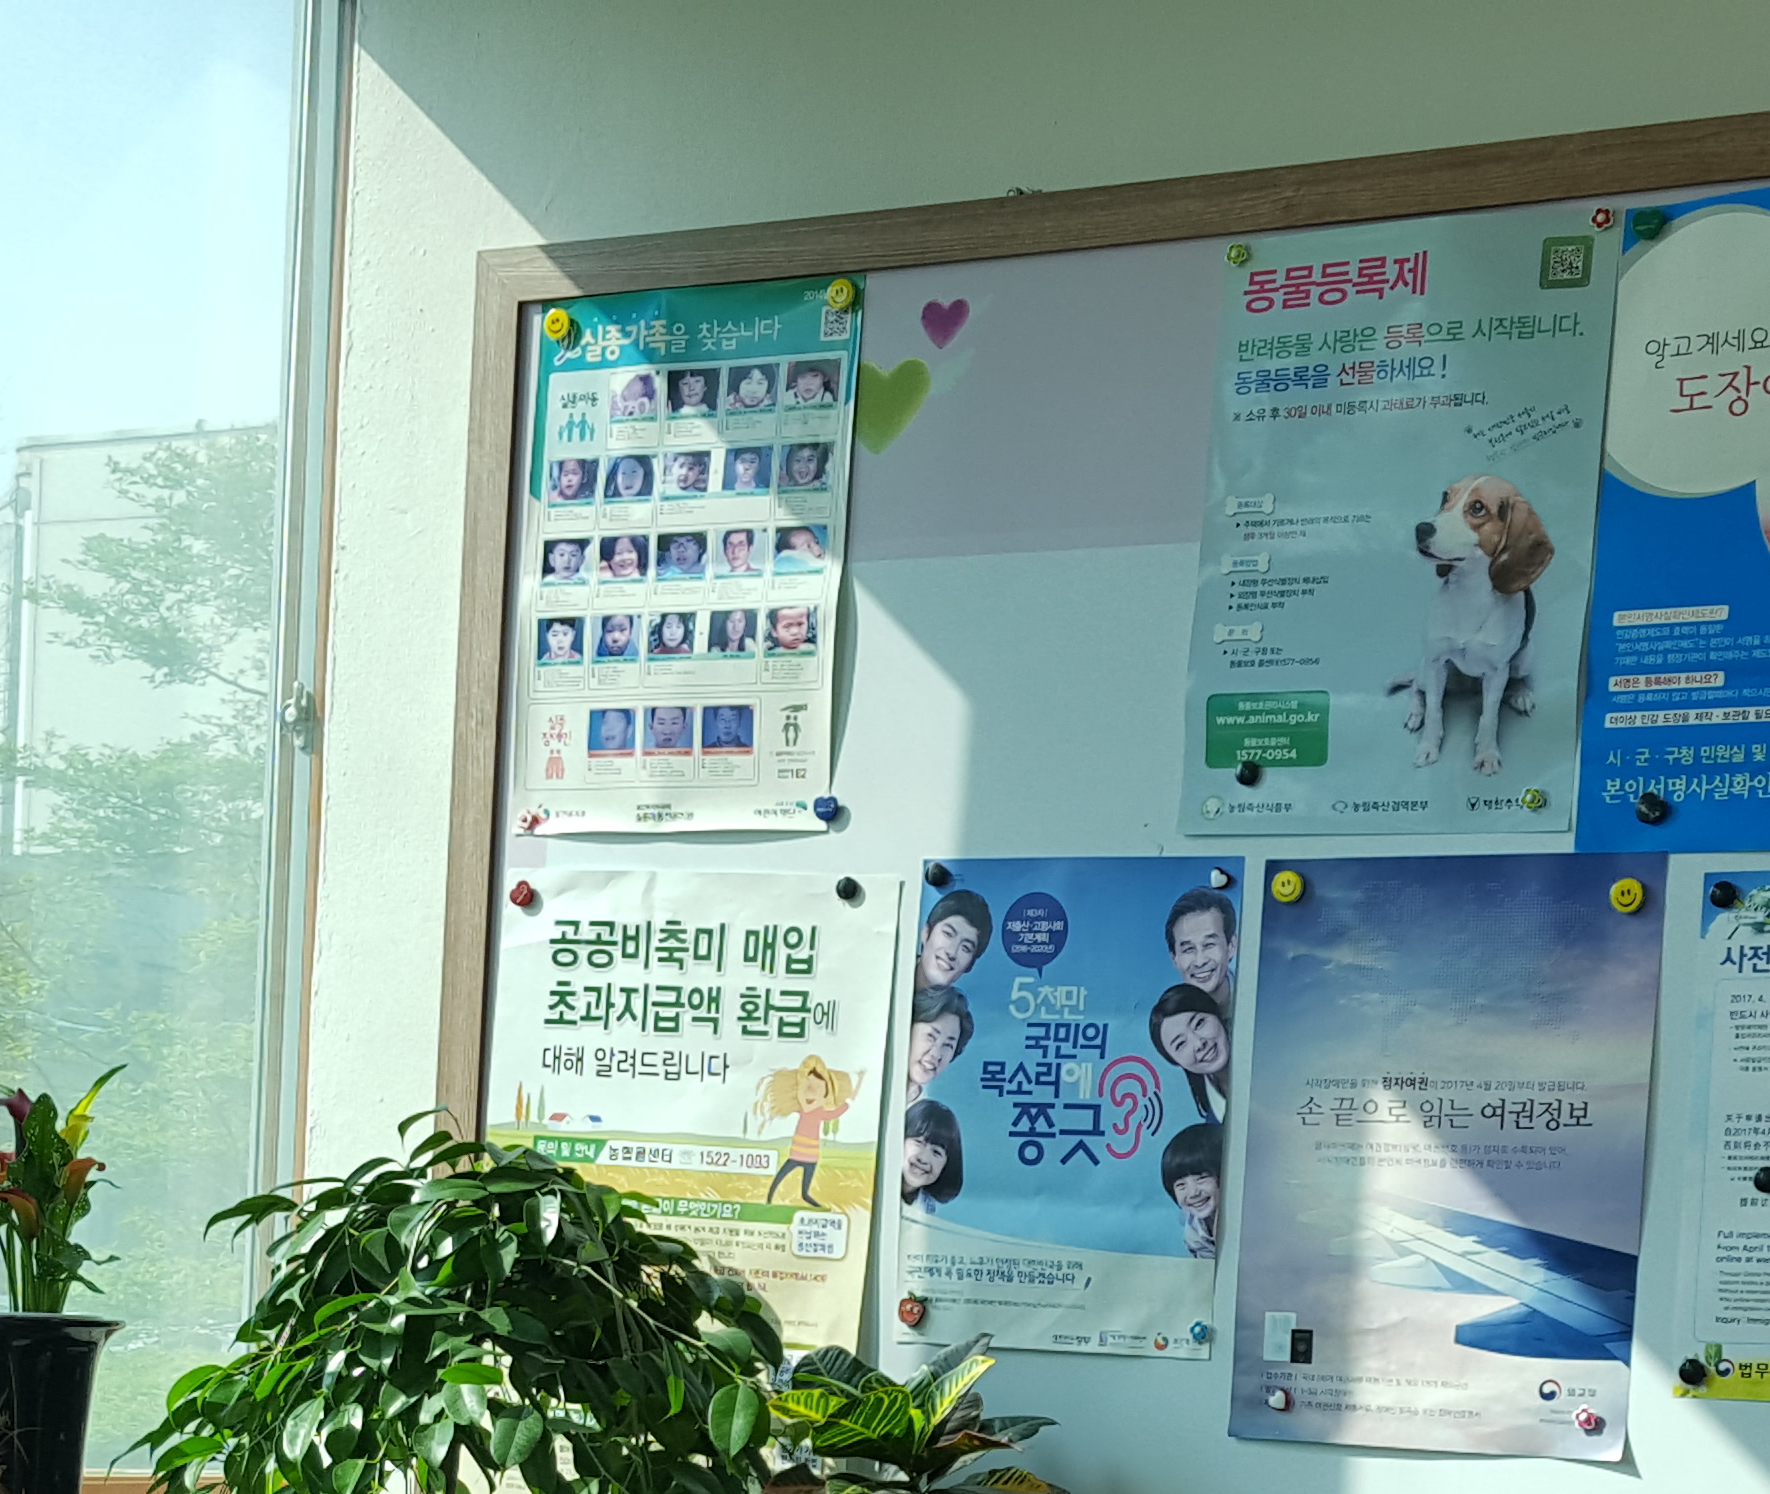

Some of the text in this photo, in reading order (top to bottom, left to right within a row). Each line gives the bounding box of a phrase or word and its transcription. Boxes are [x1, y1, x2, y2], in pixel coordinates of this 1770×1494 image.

[1243, 250, 1428, 314] 동물등록제
[580, 315, 781, 363] 실종가족을 찾습니다
[1237, 311, 1584, 362] 반려동물 사랑은 등록으로 시작됩니다.
[1234, 363, 1330, 396] 동물등록을
[1245, 392, 1488, 422] 소유 후 30일 이내 미등록시 과태료가 부과됩니다.
[1685, 673, 1718, 685] 하나요?
[1216, 711, 1320, 727] www.animal.go.kr
[1610, 715, 1637, 726] 더이상
[1641, 714, 1658, 725] 인감
[1663, 712, 1690, 724] 도장을
[1694, 711, 1713, 722] 제작
[1235, 749, 1297, 761] 1577-0954
[1701, 743, 1766, 765] 민원실 및
[548, 919, 818, 976] 공공비축미 매입
[543, 980, 836, 1040] 초과지급액 환급에
[1008, 977, 1088, 1020] 5천만
[1730, 1009, 1757, 1020] 반드시
[1025, 1022, 1109, 1061] 국민의
[542, 1044, 730, 1084] 대해 알려드립니다
[980, 1061, 1092, 1099] 목소리에
[1297, 1096, 1593, 1132] 손 끝으로 읽는 여권정보
[1008, 1102, 1105, 1167] 쫑긋
[1717, 1230, 1734, 1239] Full
[1743, 1243, 1763, 1254] April
[1715, 1255, 1742, 1264] online
